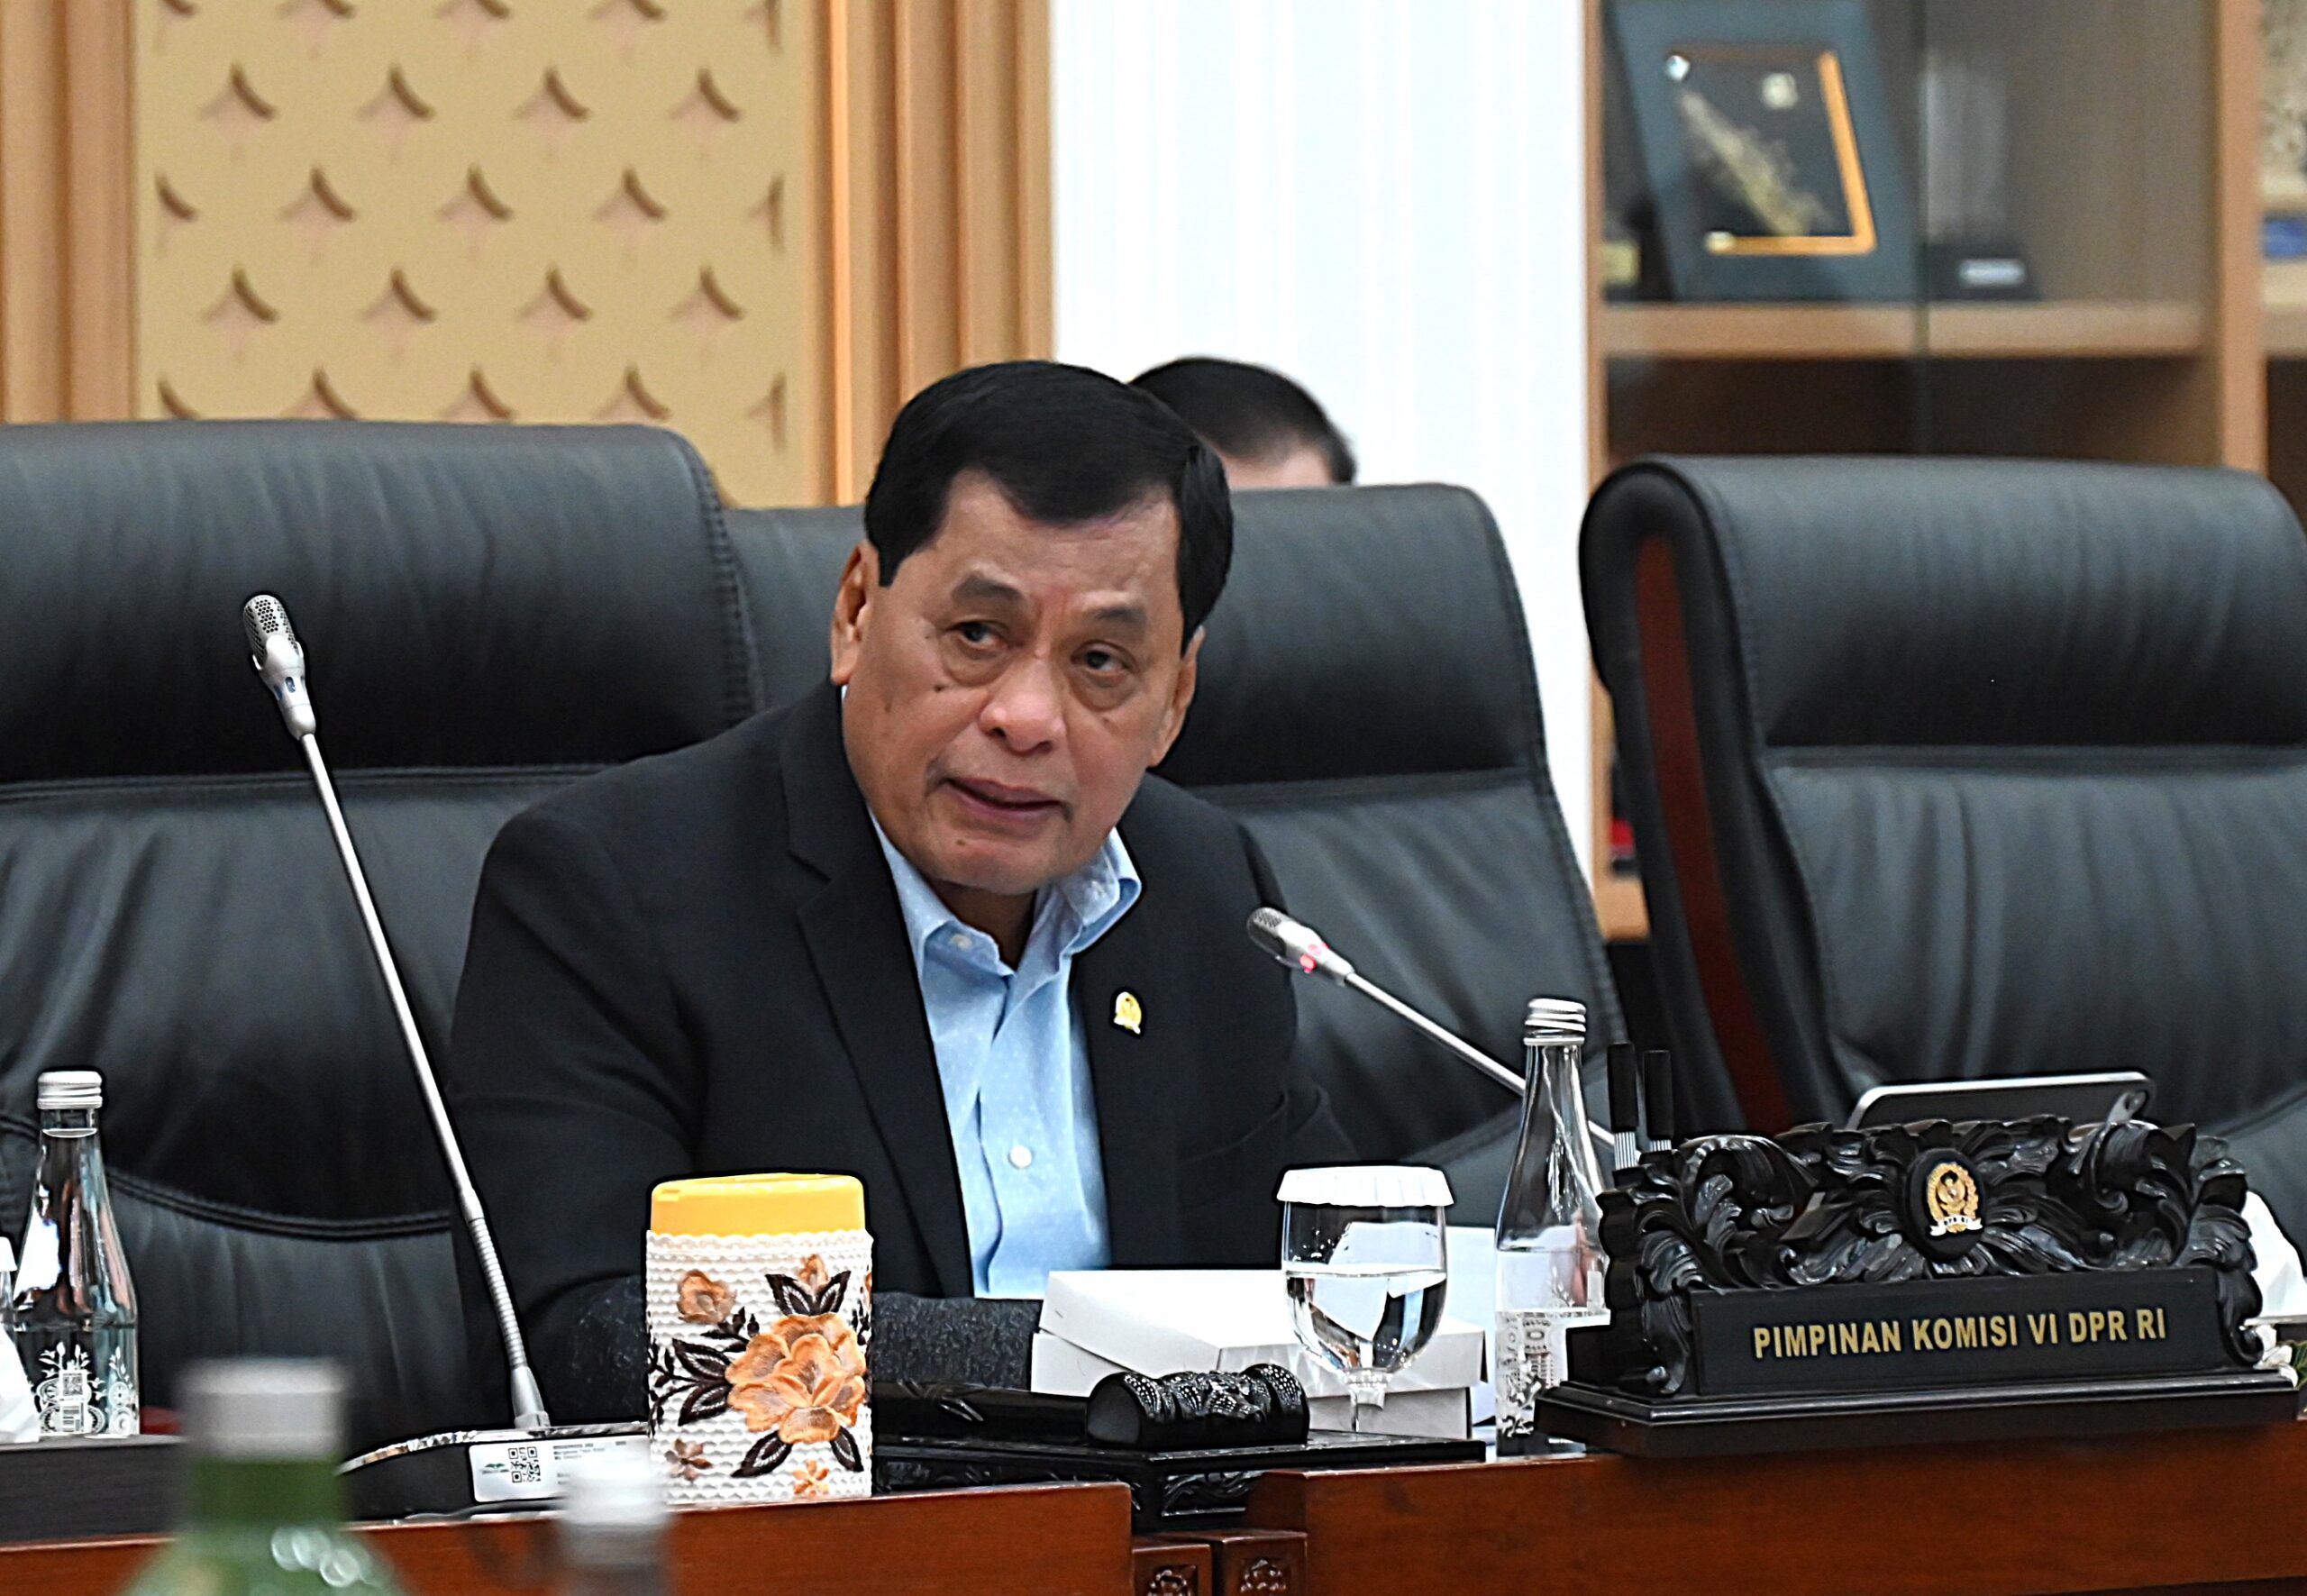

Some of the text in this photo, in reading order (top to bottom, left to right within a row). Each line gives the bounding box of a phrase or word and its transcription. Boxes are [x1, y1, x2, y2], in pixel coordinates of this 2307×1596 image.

[1755, 1309, 2166, 1357] PIMPINAN KOMISI VI DPR RI
